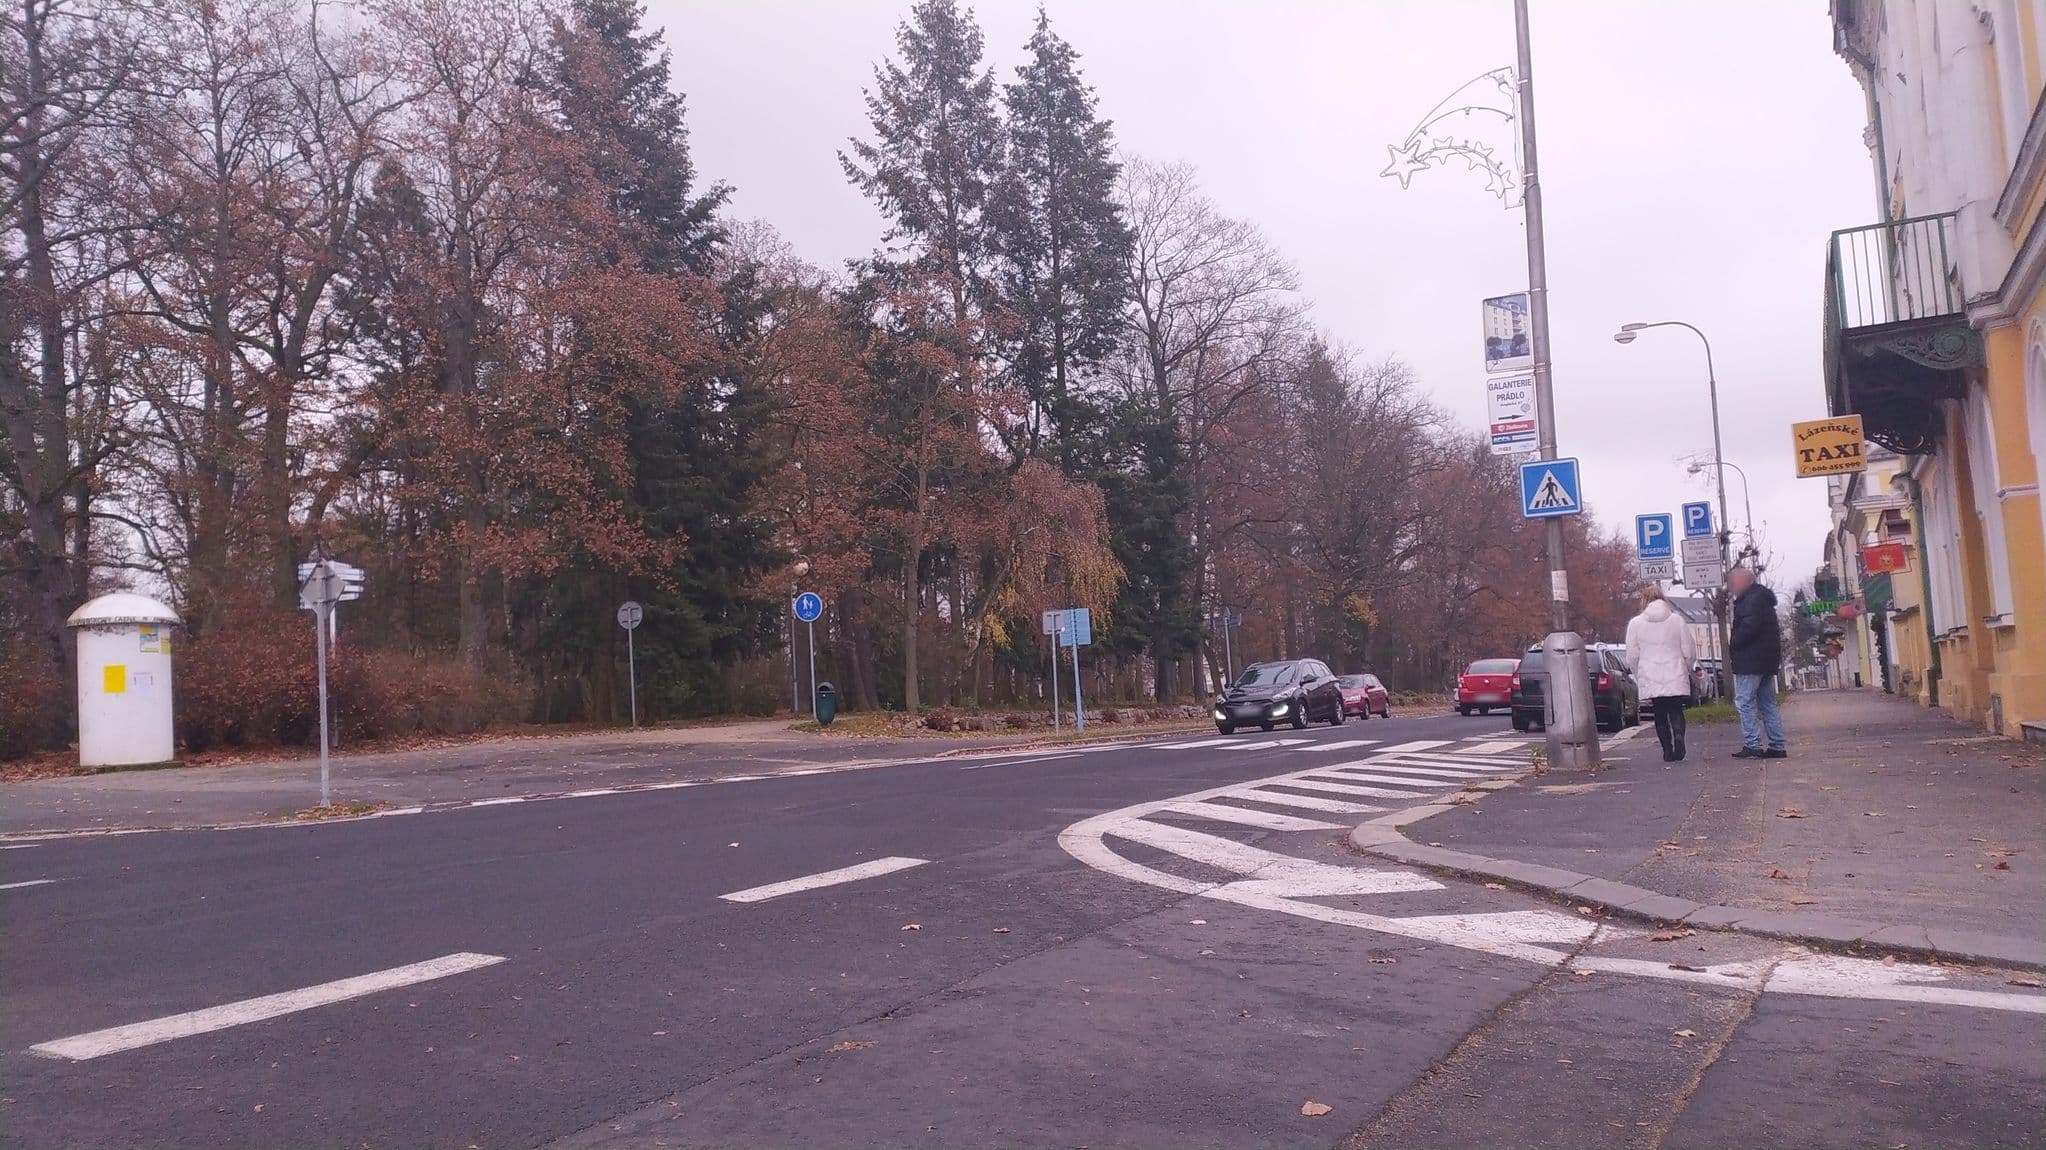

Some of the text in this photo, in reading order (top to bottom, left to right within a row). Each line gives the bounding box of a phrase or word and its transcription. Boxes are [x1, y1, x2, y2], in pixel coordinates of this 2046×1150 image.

[1488, 379, 1532, 391] GALANTERIE
[1496, 391, 1525, 401] PRÁDLO
[1798, 423, 1859, 441] Lázeňské
[1800, 443, 1860, 462] TAXI
[1688, 507, 1704, 528] P
[1644, 519, 1664, 546] P
[1645, 566, 1667, 574] TAXI
